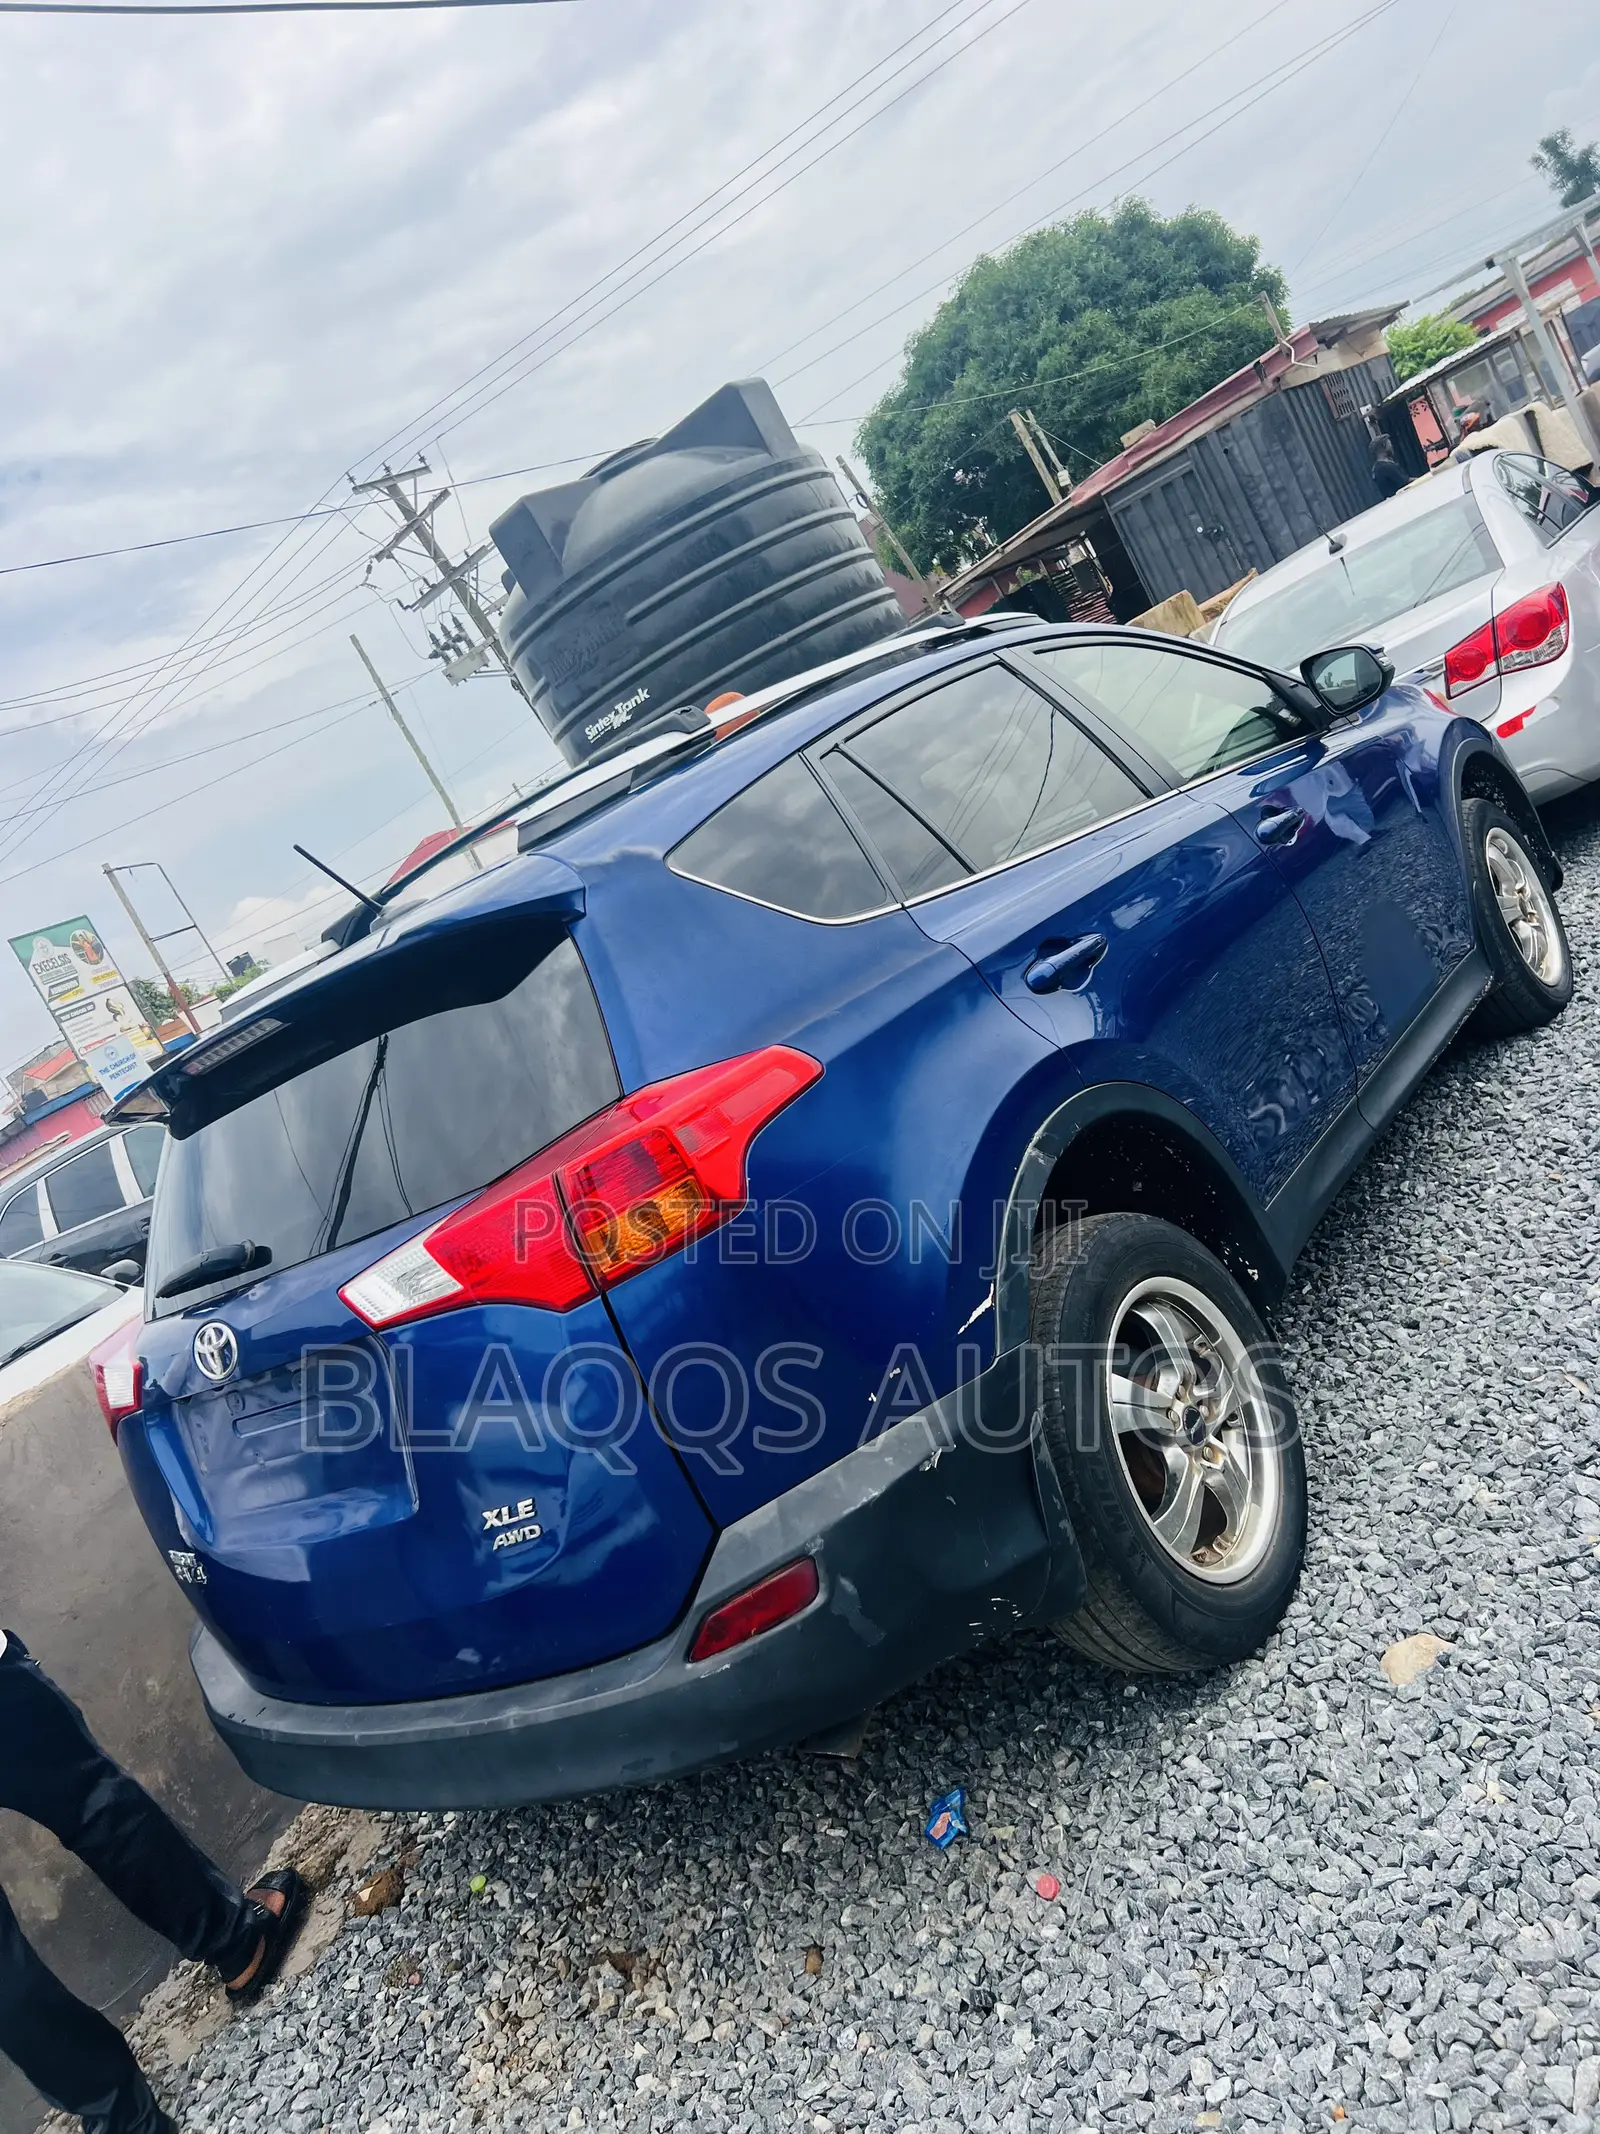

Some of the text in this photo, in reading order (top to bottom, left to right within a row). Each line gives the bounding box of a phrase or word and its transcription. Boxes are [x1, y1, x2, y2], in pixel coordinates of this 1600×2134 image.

[585, 711, 616, 740] Sintex
[615, 688, 651, 714] Tank
[32, 953, 72, 975] EXECELSIS
[98, 1066, 111, 1075] THE
[110, 1056, 130, 1070] CHURCH
[109, 1061, 138, 1080] PENTECOST
[481, 1498, 536, 1531] XLE
[493, 1524, 542, 1551] AWD
